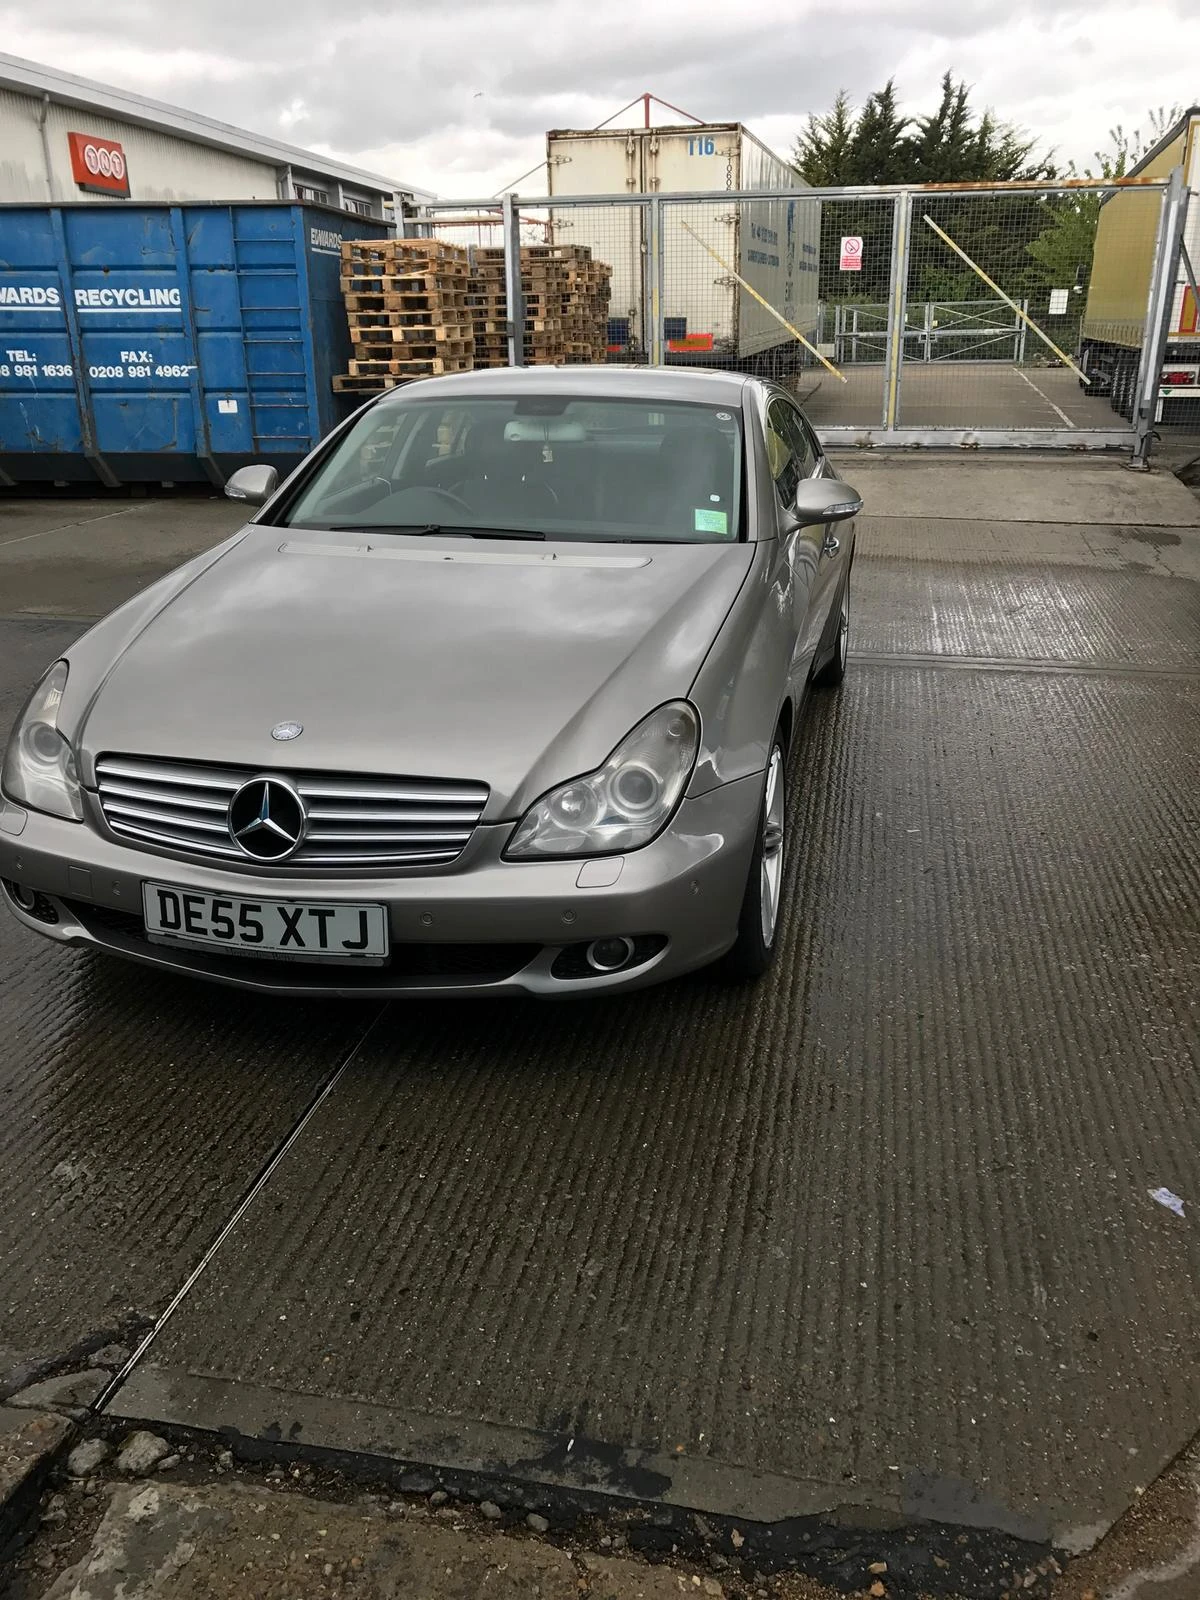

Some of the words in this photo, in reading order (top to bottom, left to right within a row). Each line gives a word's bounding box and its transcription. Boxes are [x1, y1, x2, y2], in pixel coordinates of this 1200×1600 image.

[688, 135, 714, 156] T16
[86, 147, 122, 177] TNT
[74, 288, 181, 306] RECYCLING
[6, 350, 37, 362] TEL:
[120, 351, 153, 363] FAX:
[14, 365, 38, 377] 981
[41, 365, 73, 377] 1636
[89, 366, 124, 378] 0208
[128, 366, 151, 378] 981
[155, 365, 189, 378] 4962
[157, 889, 264, 943] DE55
[277, 906, 369, 950] XTJ
